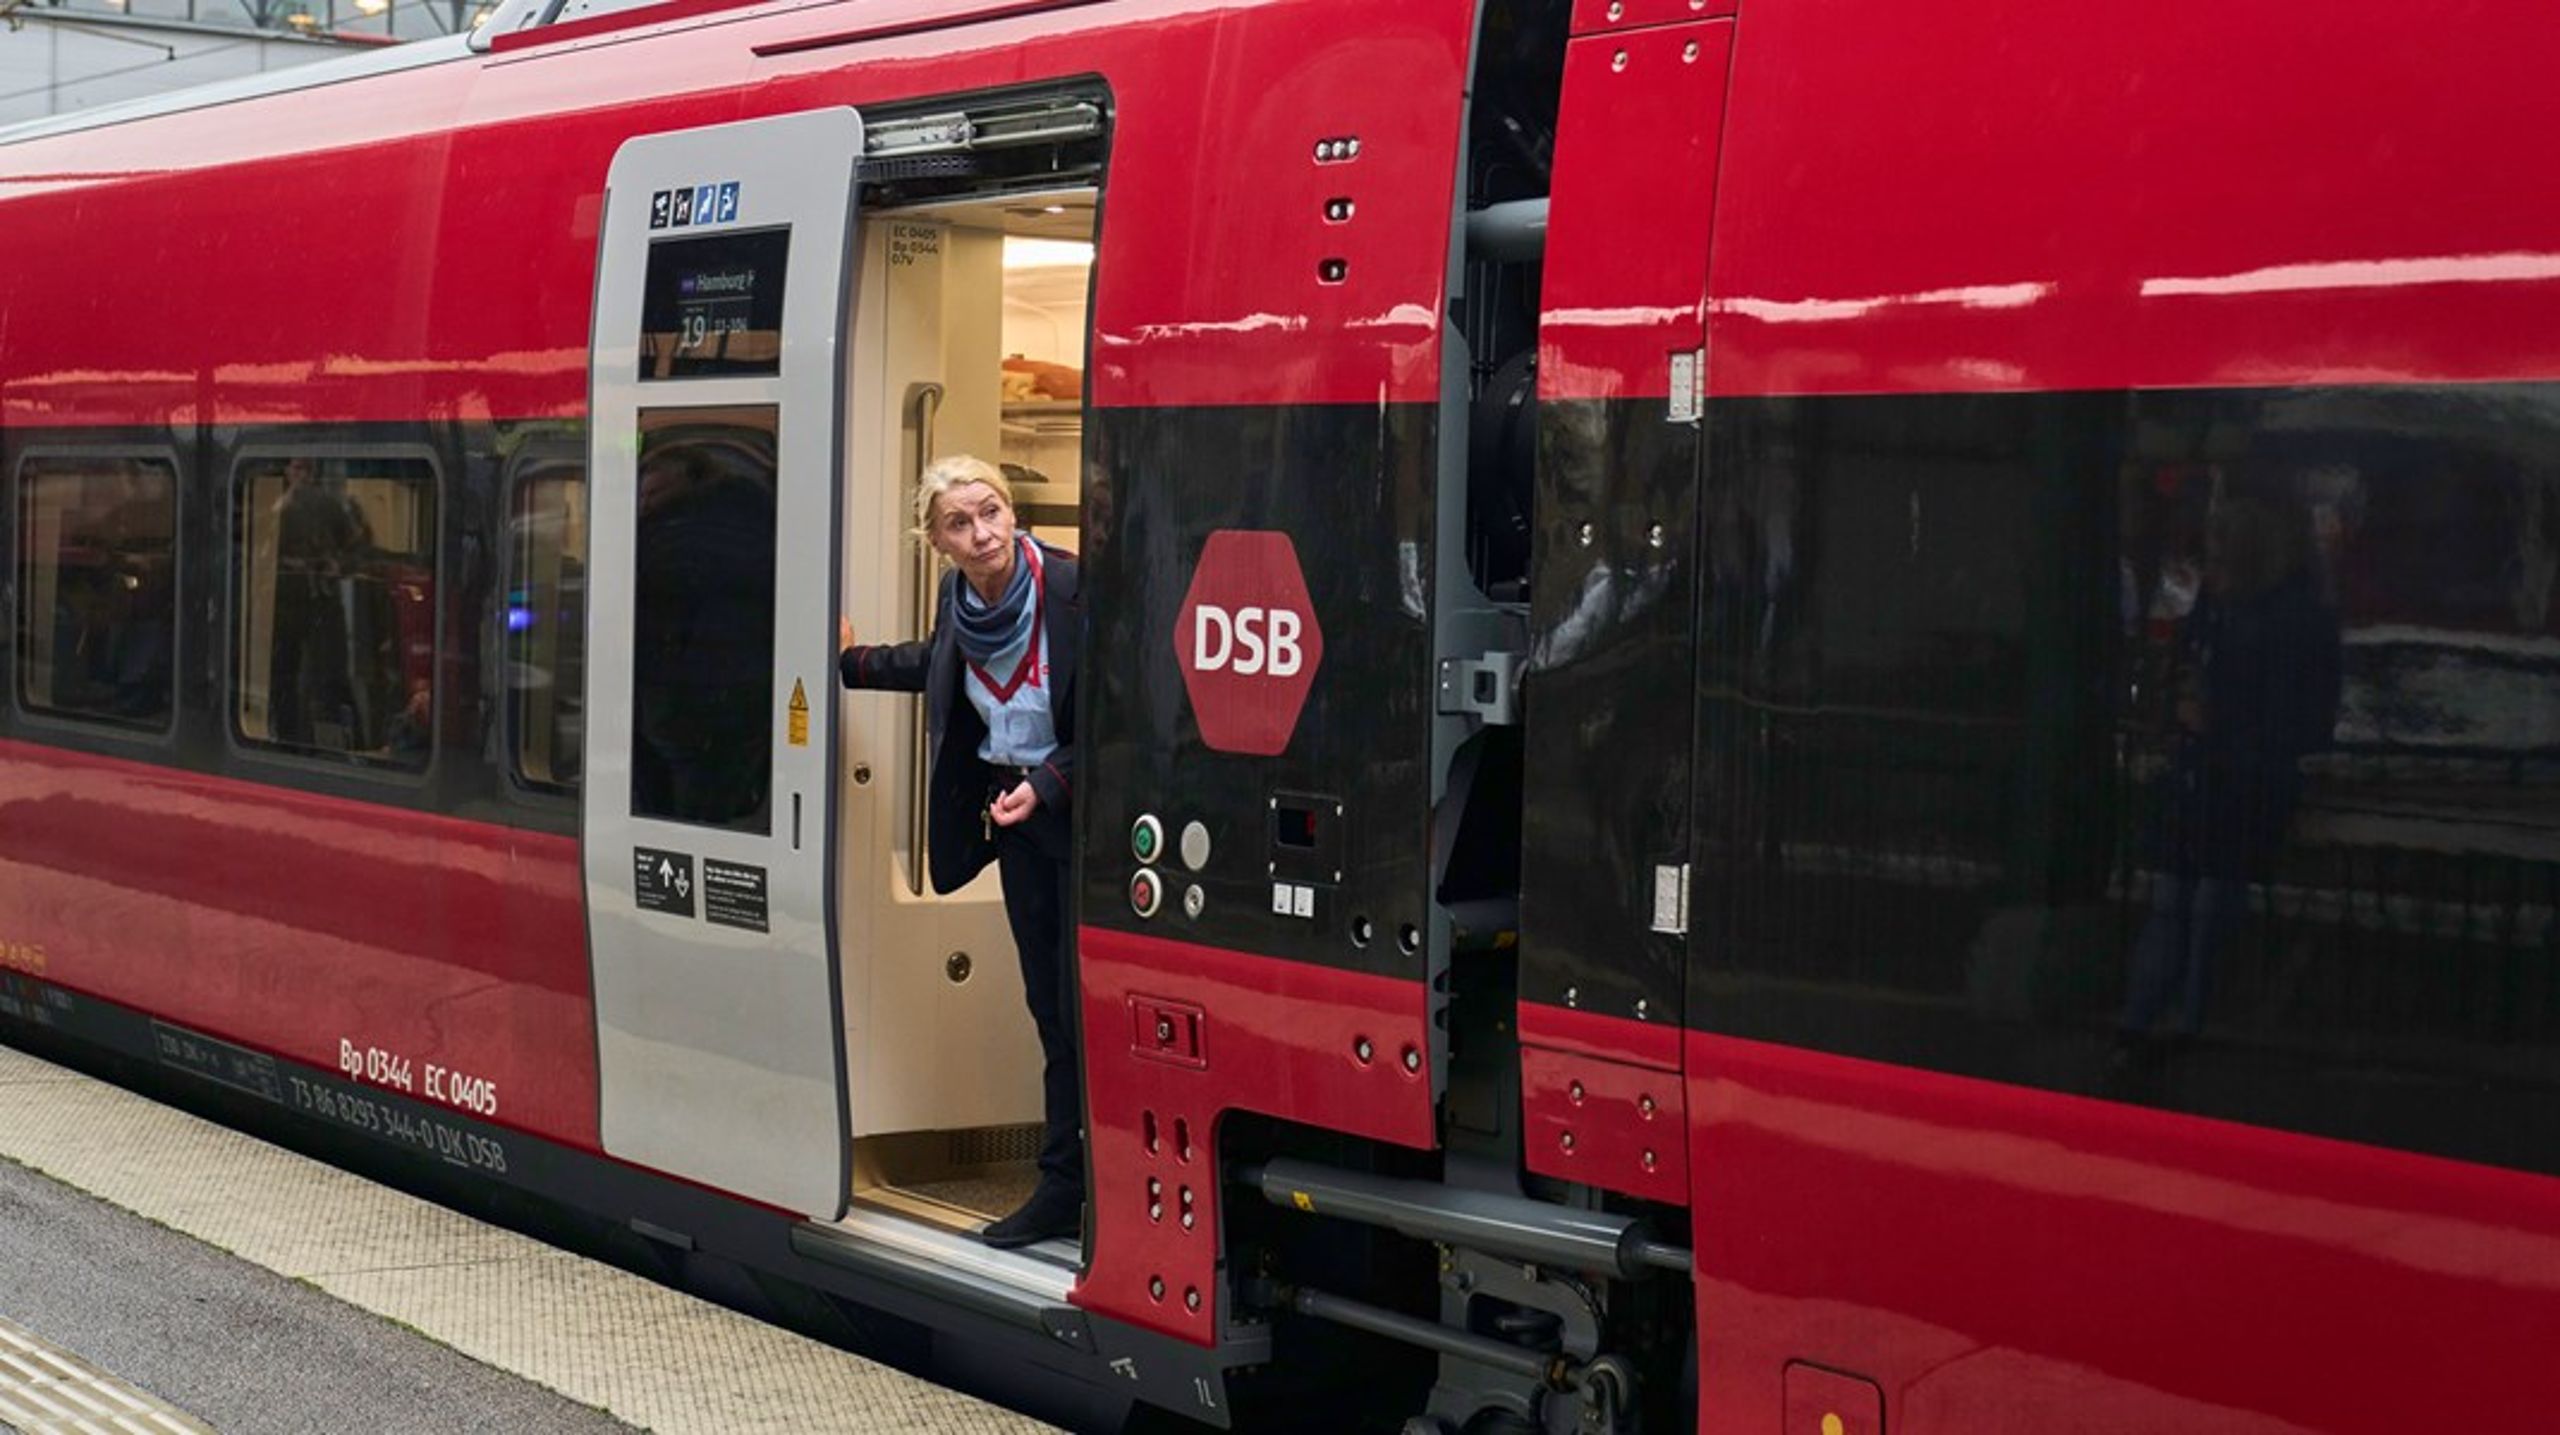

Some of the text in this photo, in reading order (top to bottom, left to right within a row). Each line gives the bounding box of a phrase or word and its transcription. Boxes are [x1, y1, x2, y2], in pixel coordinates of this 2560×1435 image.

[909, 227, 937, 240] 0405
[910, 241, 939, 254] 0344
[697, 273, 745, 292] Hamburg
[681, 315, 705, 348] 19
[1194, 603, 1303, 677] DSB
[339, 1037, 497, 1116] Bp 0344 EC 0405
[289, 1077, 507, 1173] 73 86 8293 344-0 DK DSB
